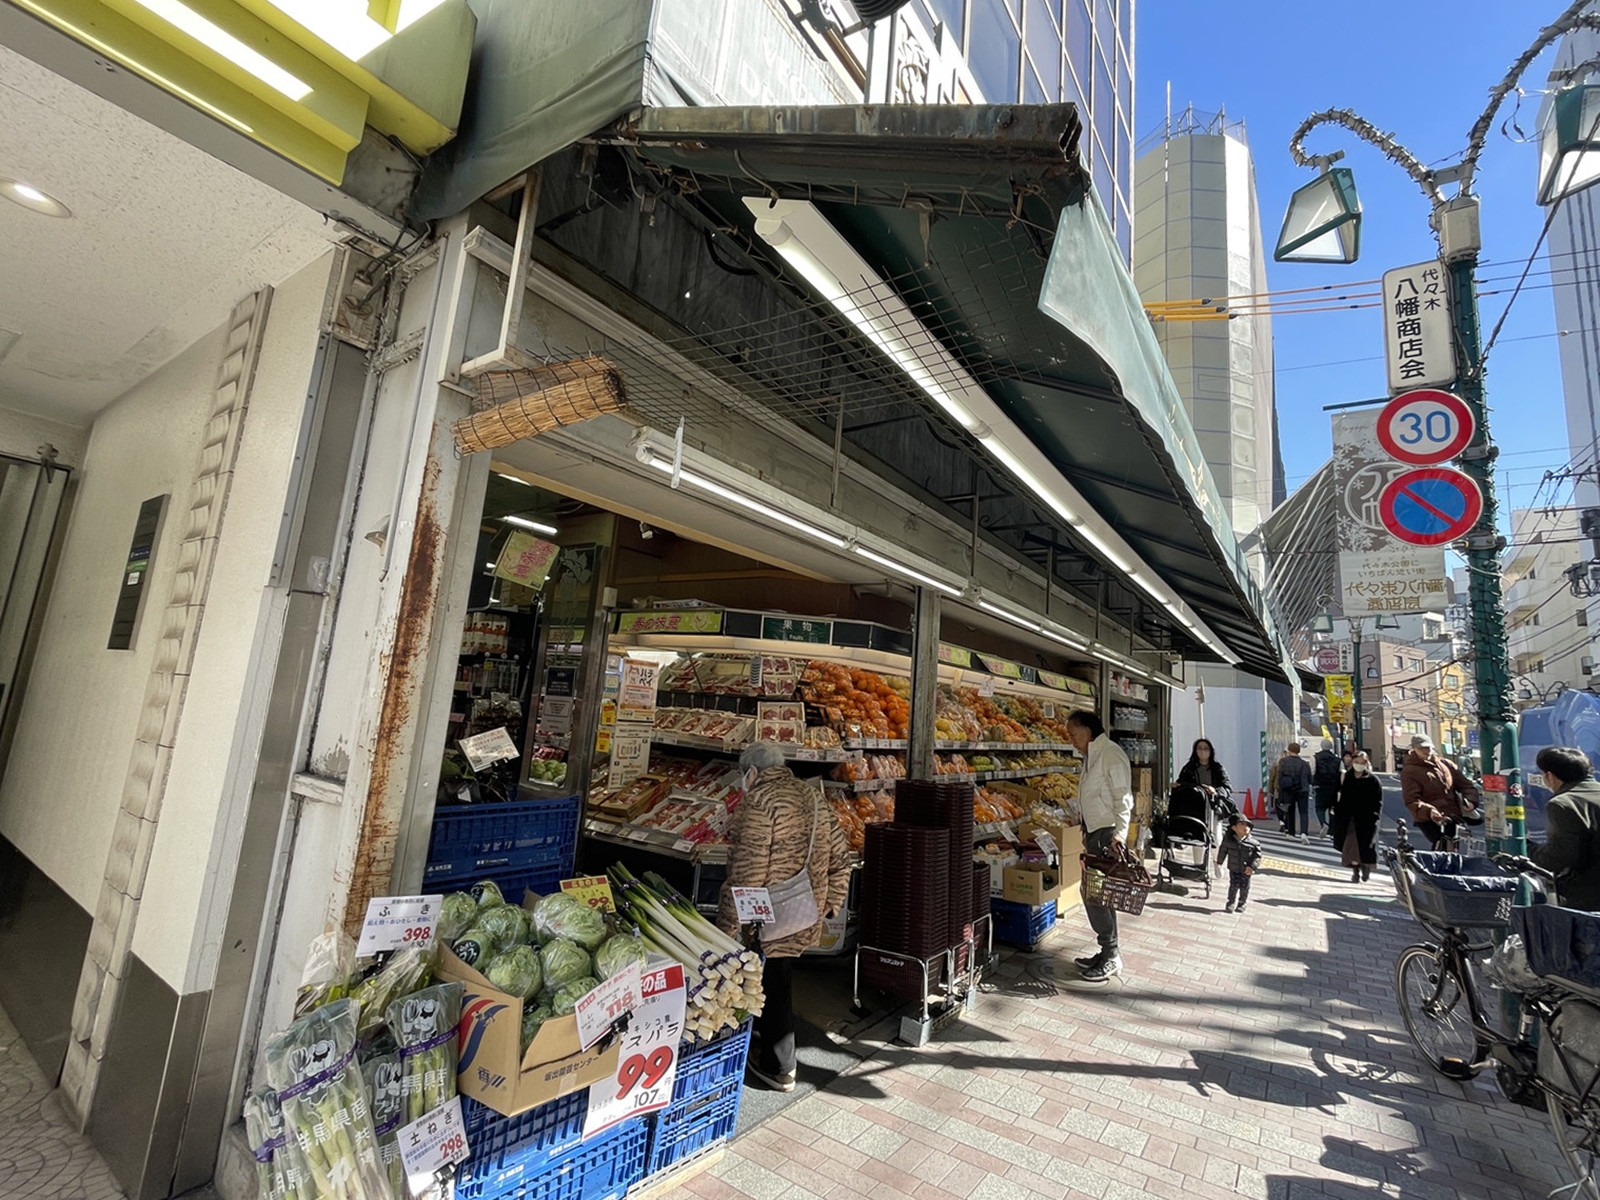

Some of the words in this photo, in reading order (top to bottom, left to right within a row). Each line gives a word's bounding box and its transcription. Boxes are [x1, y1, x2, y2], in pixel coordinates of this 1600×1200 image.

[1421, 269, 1441, 310] 代々木
[1394, 278, 1425, 380] 八幡商店会
[1400, 410, 1451, 444] 30
[1358, 568, 1426, 578] いちばん近い街
[1362, 560, 1420, 570] 代々木公園に
[1345, 578, 1444, 597] 代々木八幡
[783, 619, 812, 632] 果物
[379, 903, 431, 917] ふき
[588, 896, 609, 907] 99
[752, 905, 771, 915] 158
[402, 926, 431, 942] 398
[641, 971, 667, 993] の品
[606, 991, 633, 1018] 118
[620, 1022, 679, 1050] スパラ
[615, 1046, 674, 1100] 99
[634, 1089, 659, 1108] 107
[410, 1108, 453, 1147] 土ねぎ
[440, 1133, 463, 1160] 298
